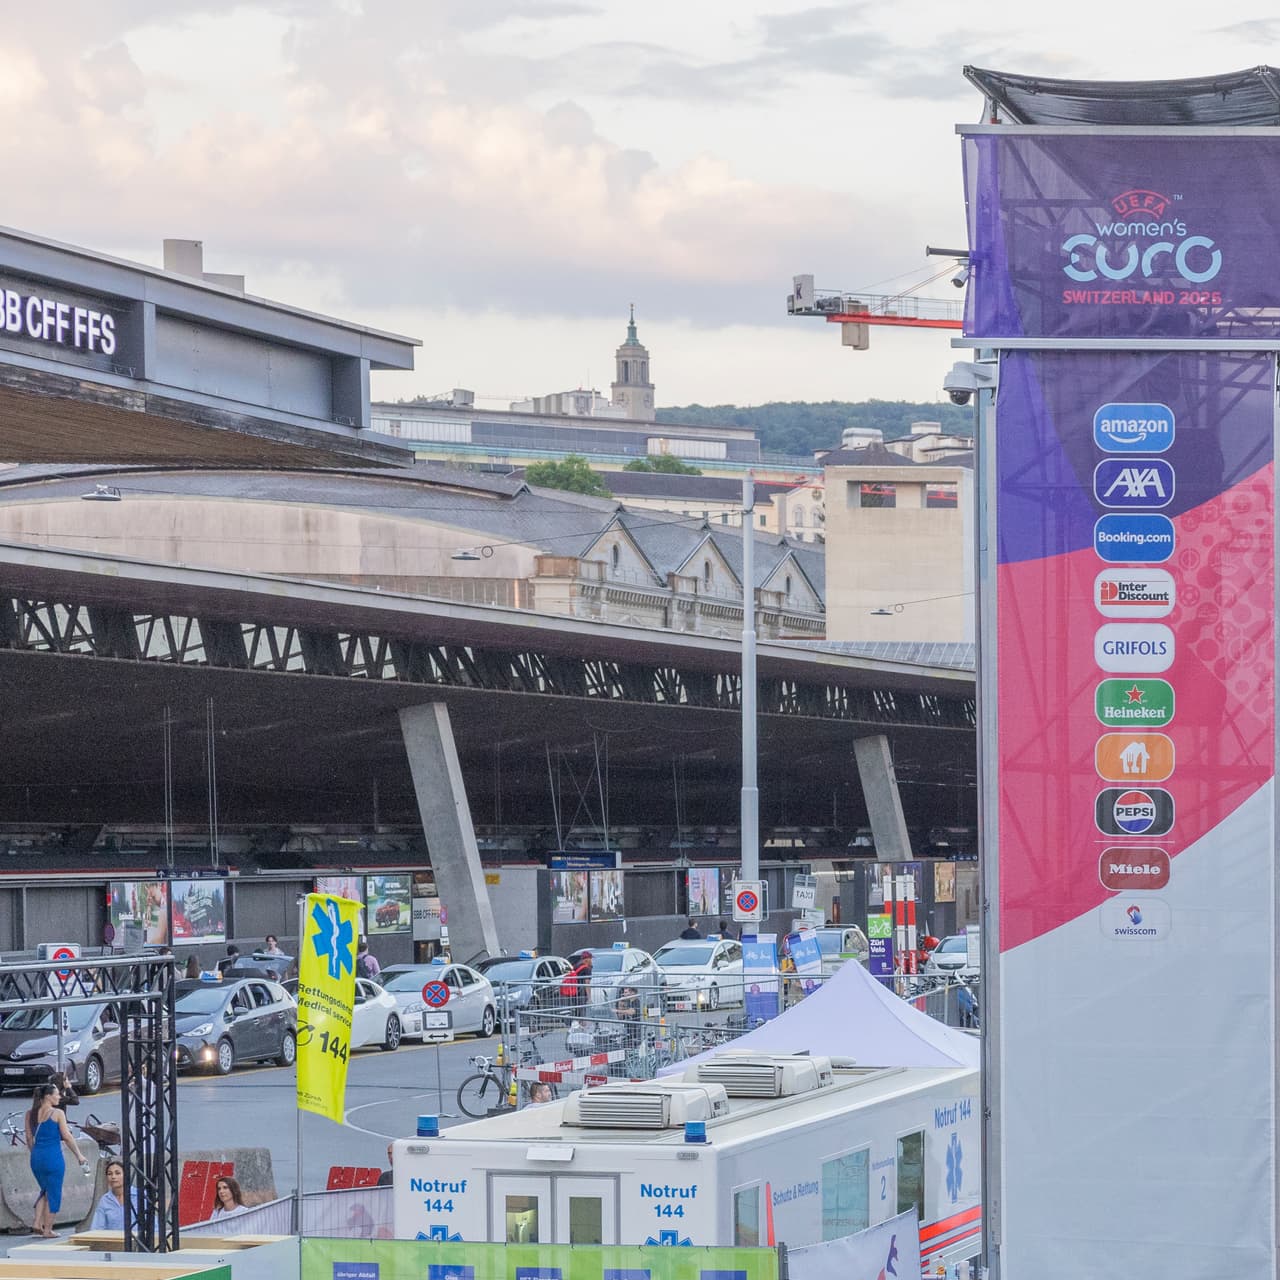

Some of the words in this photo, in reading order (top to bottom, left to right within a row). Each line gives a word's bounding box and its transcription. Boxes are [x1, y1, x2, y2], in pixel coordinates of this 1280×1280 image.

[1113, 194, 1167, 216] UEFA
[1096, 218, 1188, 236] women's
[1062, 290, 1175, 304] SWITZERLAND
[1178, 291, 1222, 305] 2025
[26, 296, 70, 343] CFF
[74, 306, 116, 355] FFS
[1101, 419, 1169, 433] amazon
[1103, 468, 1166, 497] AXA
[1098, 531, 1171, 544] Booking.com
[1118, 582, 1147, 592] Inter
[1118, 591, 1169, 602] Discount
[1103, 640, 1167, 656] GRIFOLS
[1104, 706, 1166, 718] Heineken
[1116, 807, 1154, 817] PEPSI
[1109, 863, 1161, 875] Miele
[1114, 926, 1157, 935] swisscom
[319, 1031, 348, 1065] 144
[934, 1105, 958, 1129] Notruf
[960, 1098, 972, 1120] 144
[410, 1178, 468, 1193] Notruf
[640, 1183, 698, 1199] Notruf
[880, 1176, 887, 1201] 2
[773, 1188, 793, 1207] Schutz
[793, 1187, 798, 1199] &
[798, 1180, 819, 1199] Rettung
[424, 1199, 454, 1213] 144
[654, 1204, 685, 1218] 144
